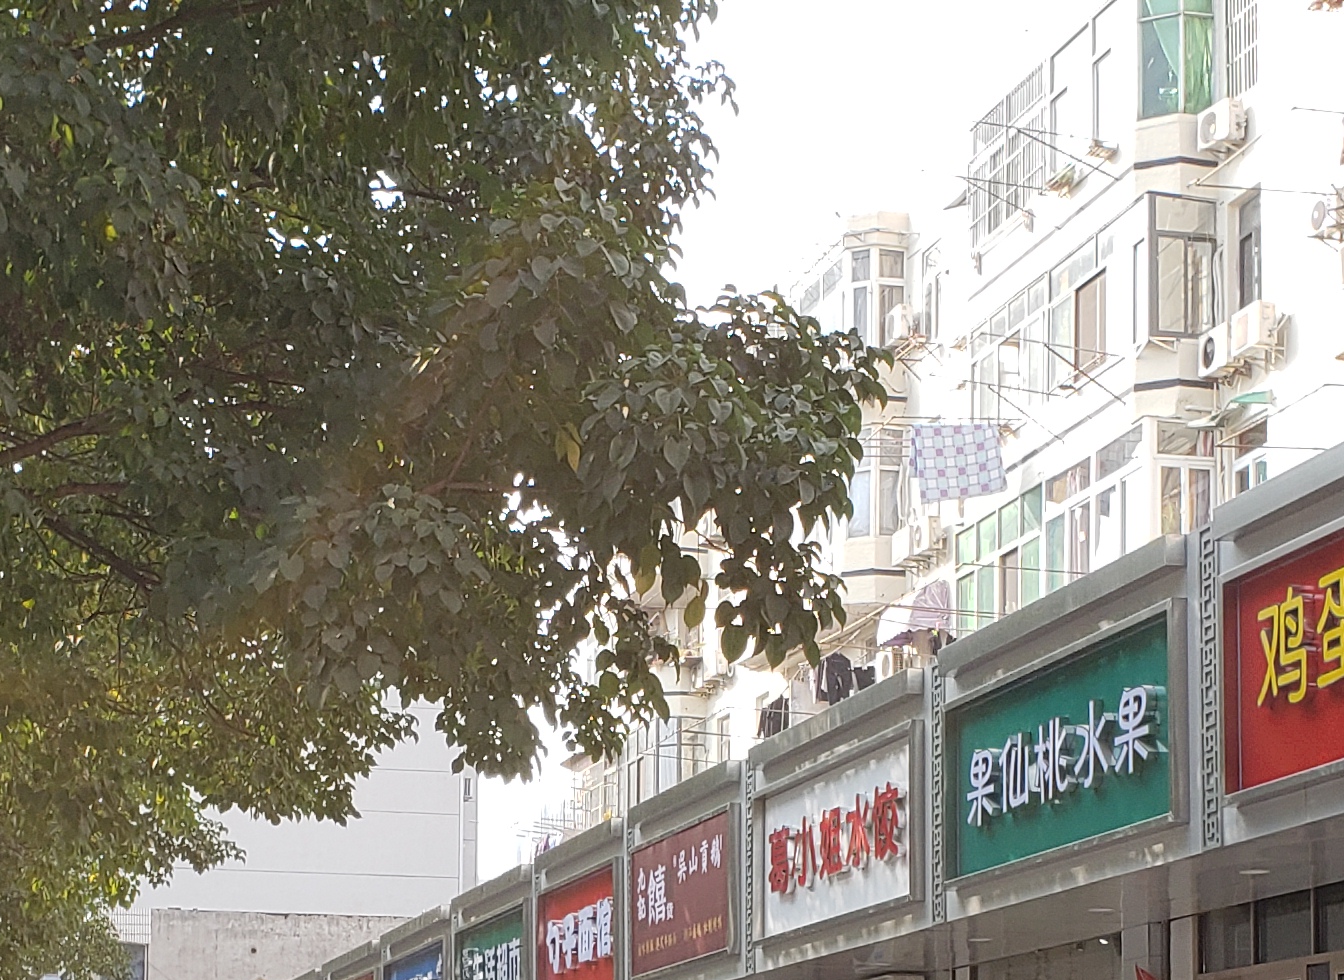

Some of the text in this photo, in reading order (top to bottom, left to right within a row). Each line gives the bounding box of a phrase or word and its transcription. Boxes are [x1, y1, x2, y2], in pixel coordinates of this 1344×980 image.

[966, 686, 1151, 827] 果仙桃水果
[768, 781, 899, 894] 葛小姐水饺
